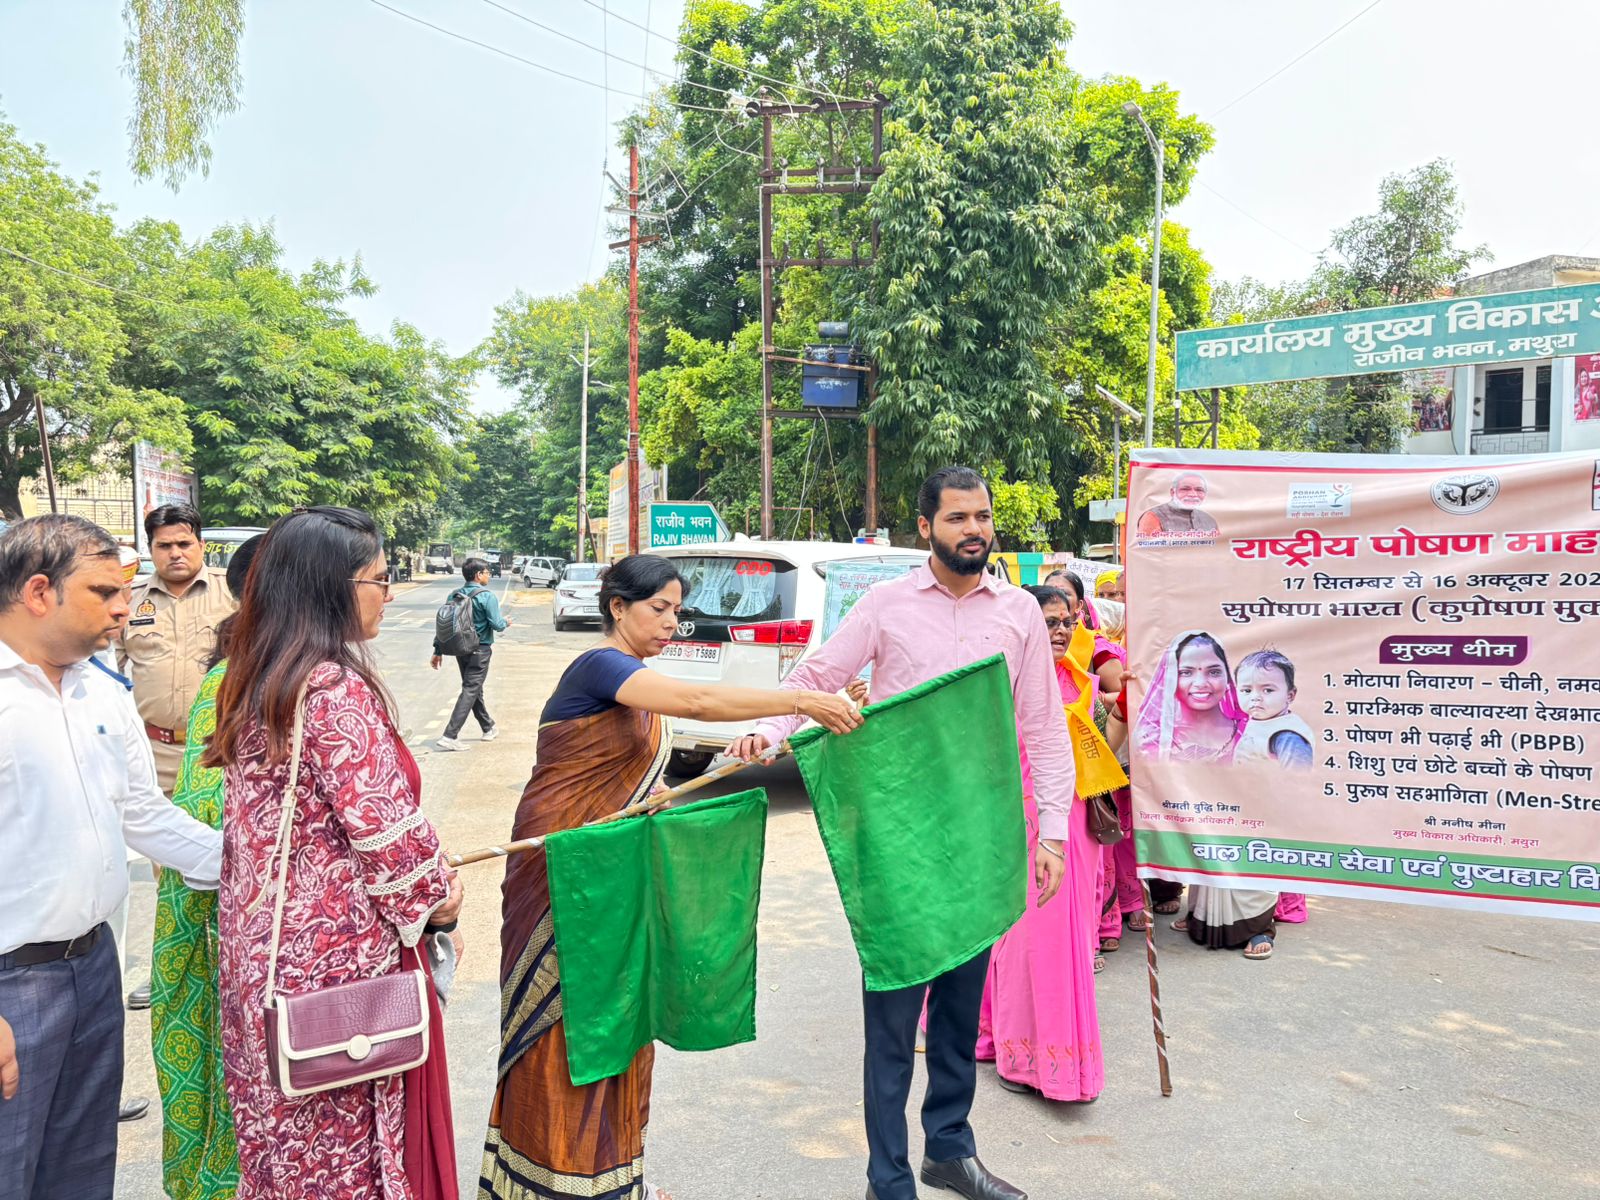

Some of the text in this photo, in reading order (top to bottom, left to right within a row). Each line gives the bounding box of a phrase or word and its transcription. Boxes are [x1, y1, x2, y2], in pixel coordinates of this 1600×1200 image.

[1196, 323, 1334, 358] कार्यालय
[1343, 314, 1436, 352] मुख्य
[1446, 298, 1583, 334] विकास
[1353, 344, 1425, 367] राजीव
[1508, 333, 1578, 356] मथुरा
[656, 512, 712, 528] राजीव भवन
[653, 534, 715, 545] RAJIV BHAVAN
[1232, 528, 1600, 567] राष्ट्रीय पोषण माह
[736, 561, 773, 577] CDO
[1283, 578, 1305, 590] 17
[1313, 573, 1395, 590] सितम्बर
[1403, 571, 1423, 588] से
[1432, 575, 1457, 588] 16
[1466, 573, 1550, 592] अक्टूबर
[1222, 597, 1322, 623] सुपोषण
[1330, 602, 1403, 616] भारत
[1389, 639, 1517, 661] मुख्य थीम
[1324, 674, 1336, 687] 1.
[1343, 669, 1401, 688] मोटापा
[1407, 670, 1474, 689] निवारण
[1499, 672, 1549, 694] चीनी,
[1324, 701, 1339, 714] 2.
[1346, 697, 1424, 716] प्रारम्भिक
[1429, 704, 1528, 720] बाल्यावस्था
[1324, 724, 1584, 754] 3. पोषण भी पढ़ाई भी (PBPB)
[1324, 751, 1593, 781] 4. शिशु एवं छोटे बच्चों के पोषण
[1324, 783, 1339, 796] 5.
[1395, 783, 1488, 804] सहभागिता
[1140, 811, 1160, 820] जिला
[1163, 813, 1194, 823] कार्यक्रम
[1162, 800, 1189, 811] श्रीमती
[1217, 802, 1240, 812] मिश्रा
[1424, 816, 1506, 831] श्री मनीष मीना
[1393, 829, 1416, 839] मुख्य
[1421, 830, 1453, 841] विकास
[1511, 838, 1539, 848] मथुरा
[1192, 842, 1243, 862] बाल
[1246, 839, 1334, 868] विकास
[1338, 848, 1396, 874] सेवा
[1400, 855, 1448, 878] एवं
[1449, 861, 1564, 890] पुष्टाहार
